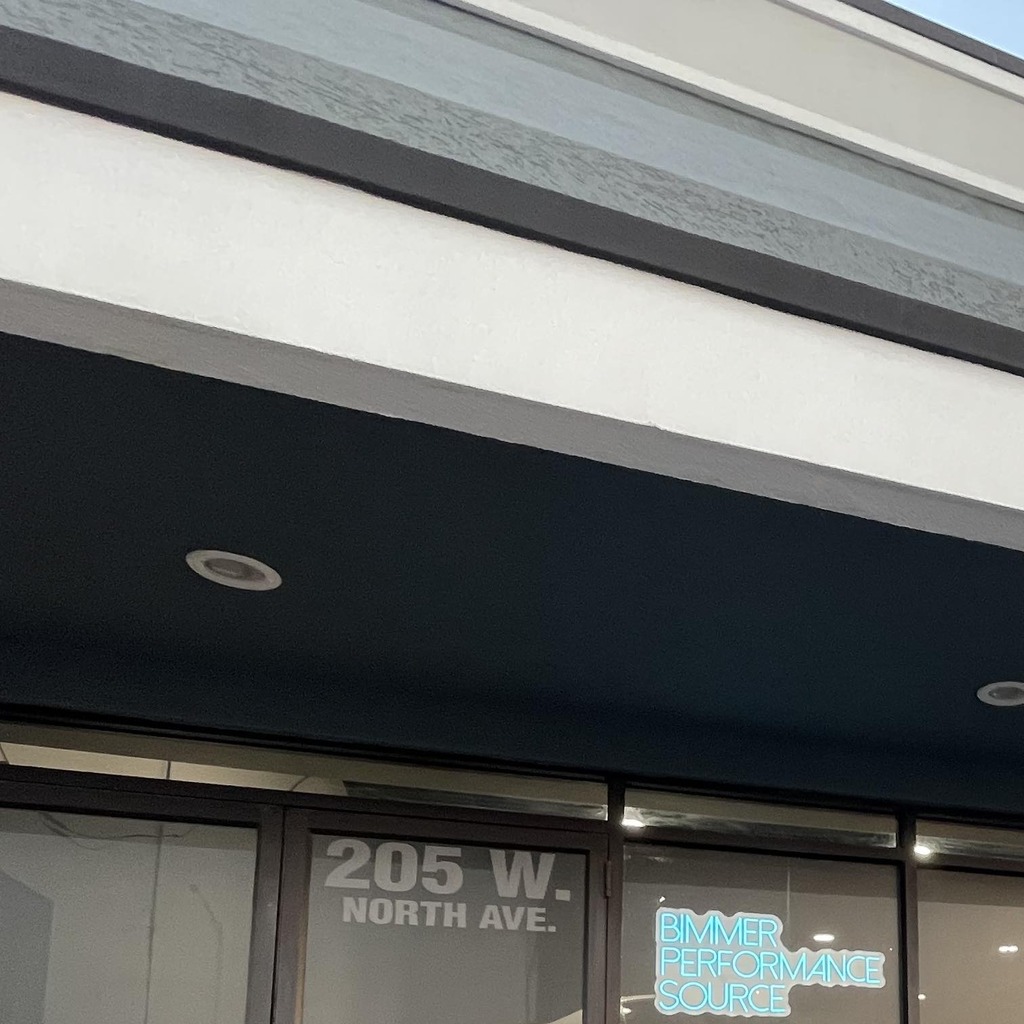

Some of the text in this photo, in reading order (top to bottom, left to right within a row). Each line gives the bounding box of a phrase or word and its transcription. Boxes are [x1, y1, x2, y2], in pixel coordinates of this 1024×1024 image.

[324, 838, 571, 901] 205 W.
[342, 896, 557, 933] NORTH AVE.
[660, 912, 778, 948] BIMMER
[660, 946, 881, 984] PERFORMANCE
[658, 979, 786, 1013] SOURCE
